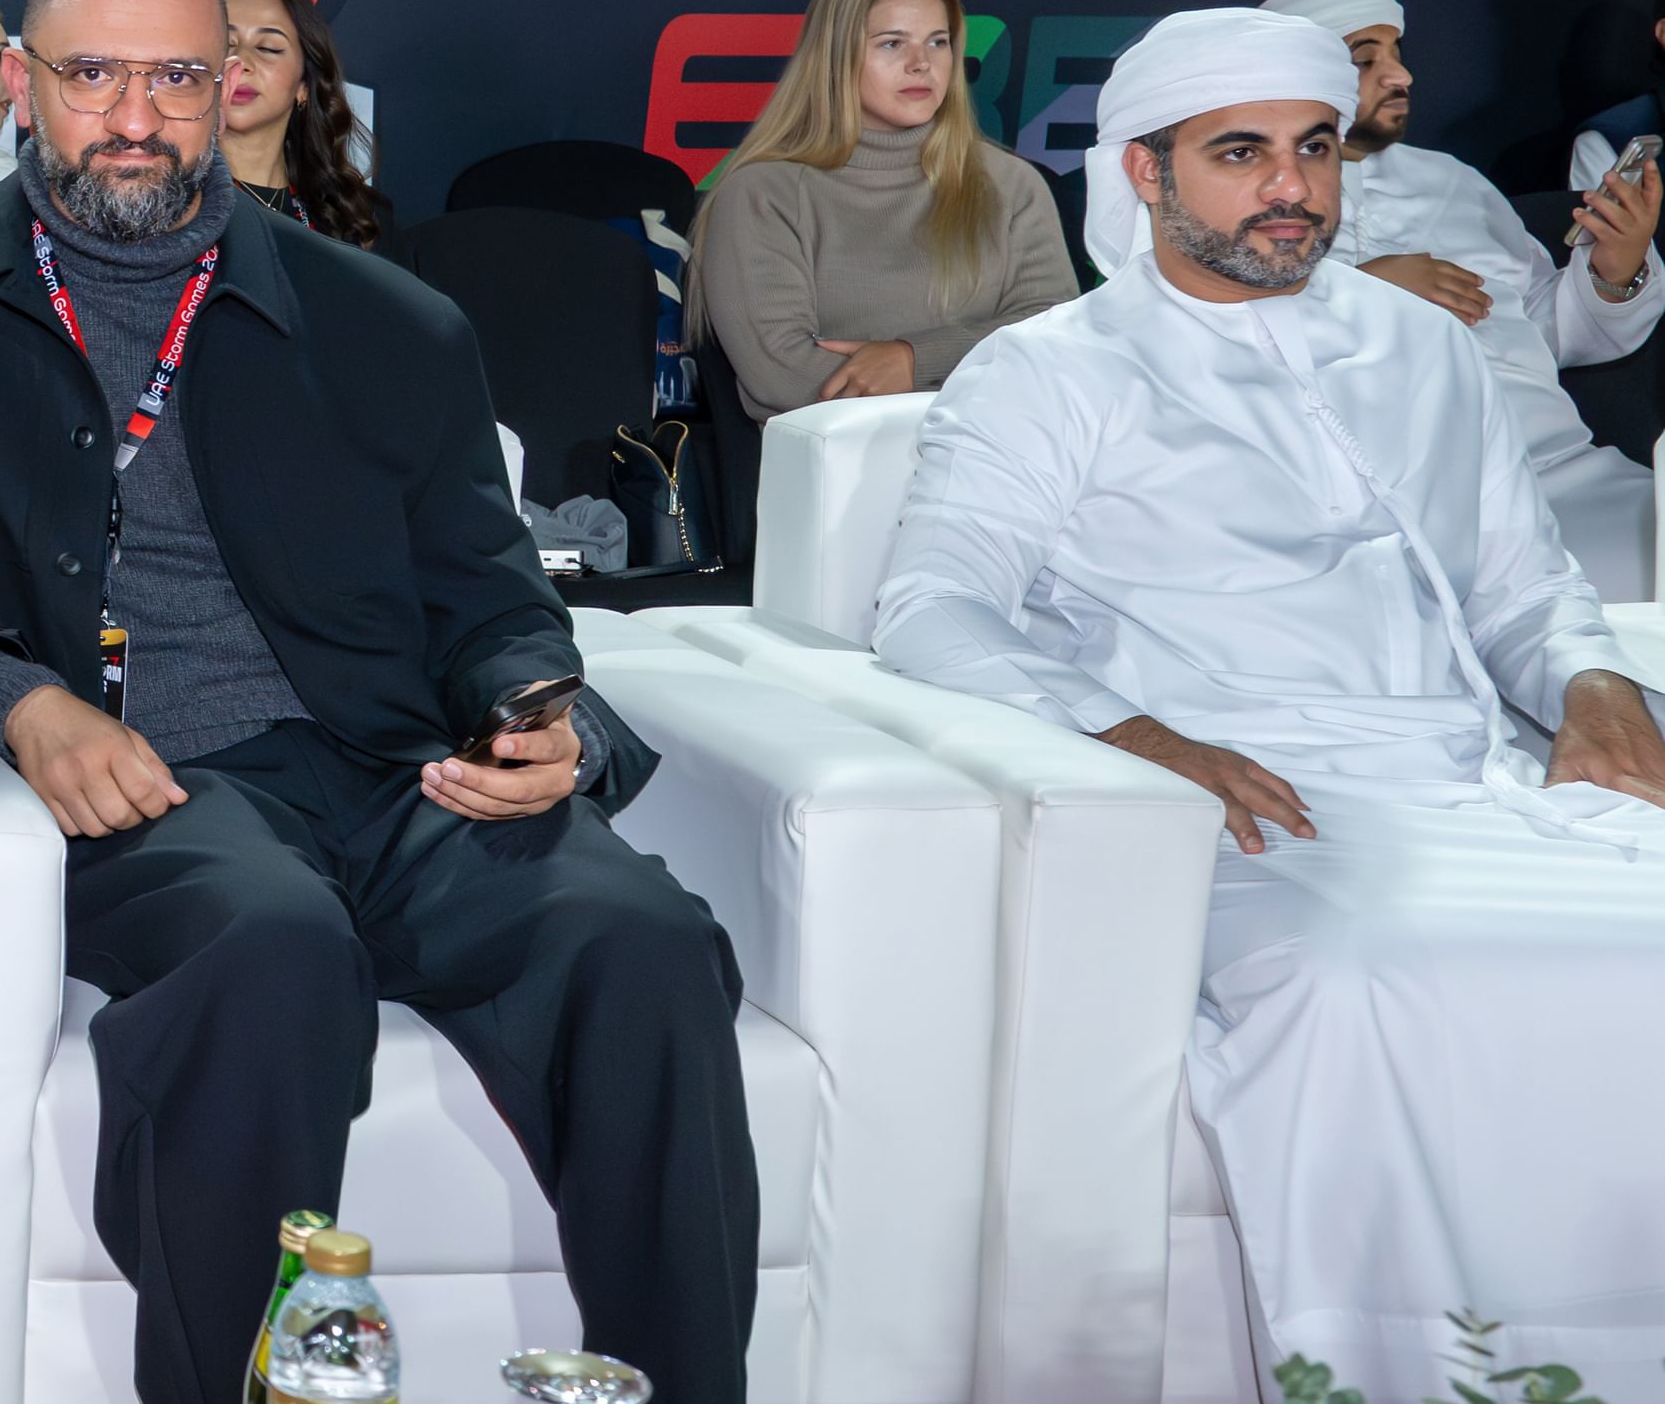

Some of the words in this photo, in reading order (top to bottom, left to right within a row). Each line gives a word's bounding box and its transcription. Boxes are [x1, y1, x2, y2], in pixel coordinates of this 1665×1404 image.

[36, 246, 60, 297] Storm
[146, 372, 170, 406] UAE
[161, 326, 188, 372] Storm
[181, 272, 210, 323] Games
[202, 246, 219, 272] 20
